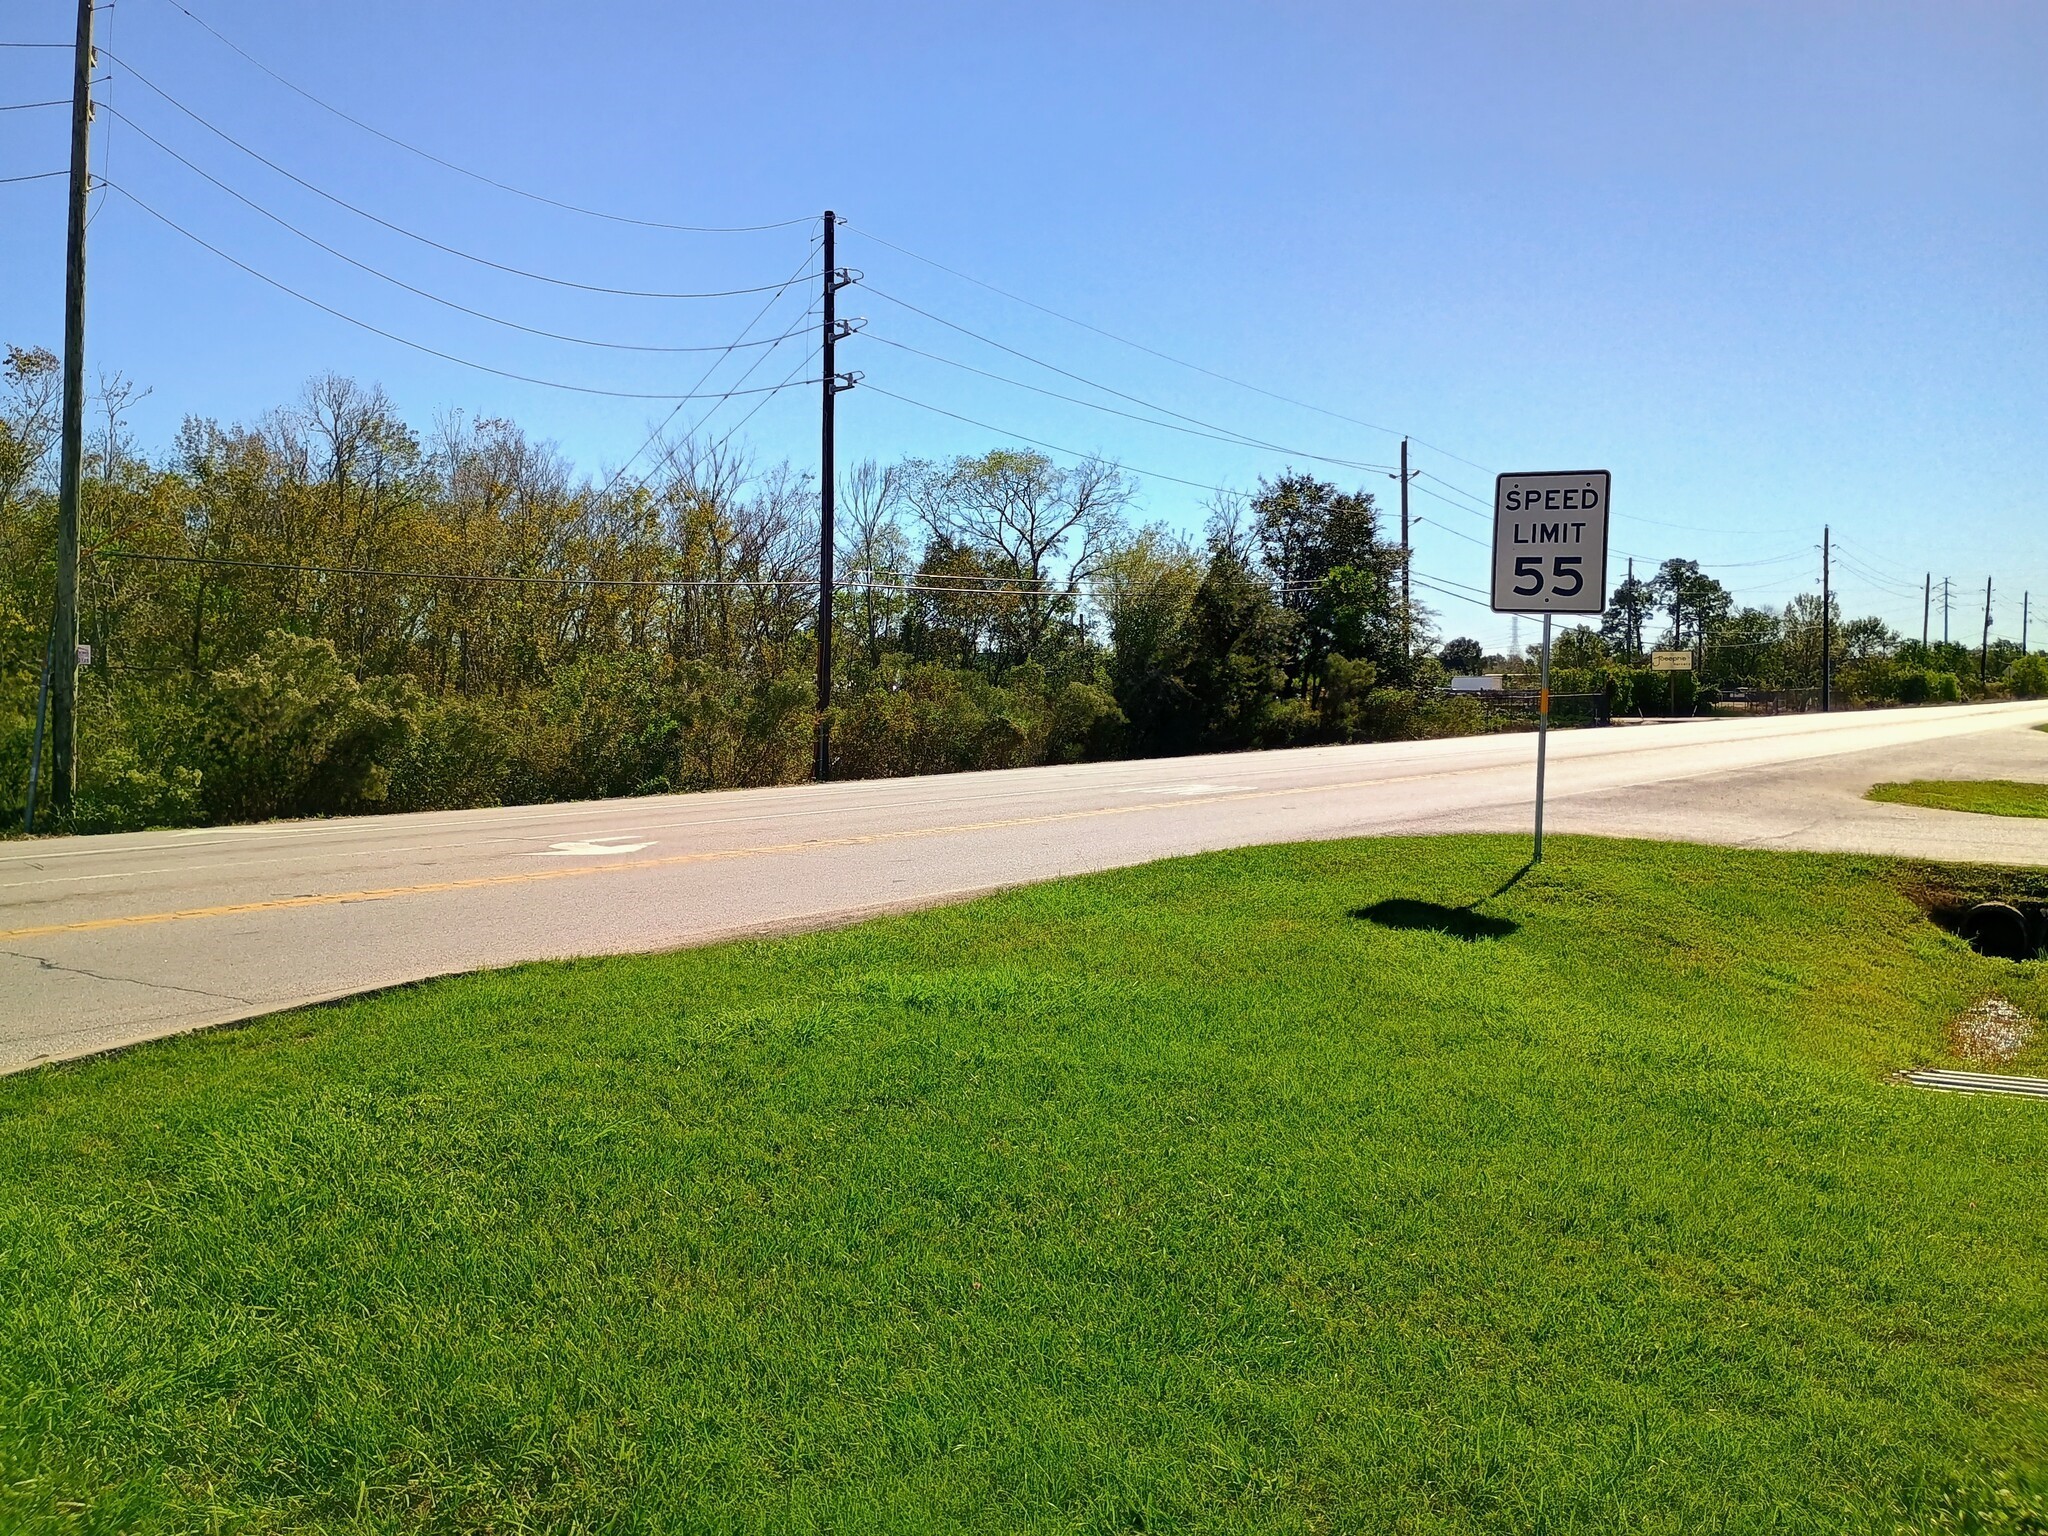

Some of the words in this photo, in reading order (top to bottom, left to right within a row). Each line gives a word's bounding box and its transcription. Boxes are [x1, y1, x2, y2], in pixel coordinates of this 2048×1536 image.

[1505, 489, 1599, 511] SPEED
[1513, 523, 1586, 544] LIMIT
[1512, 556, 1584, 597] 55
